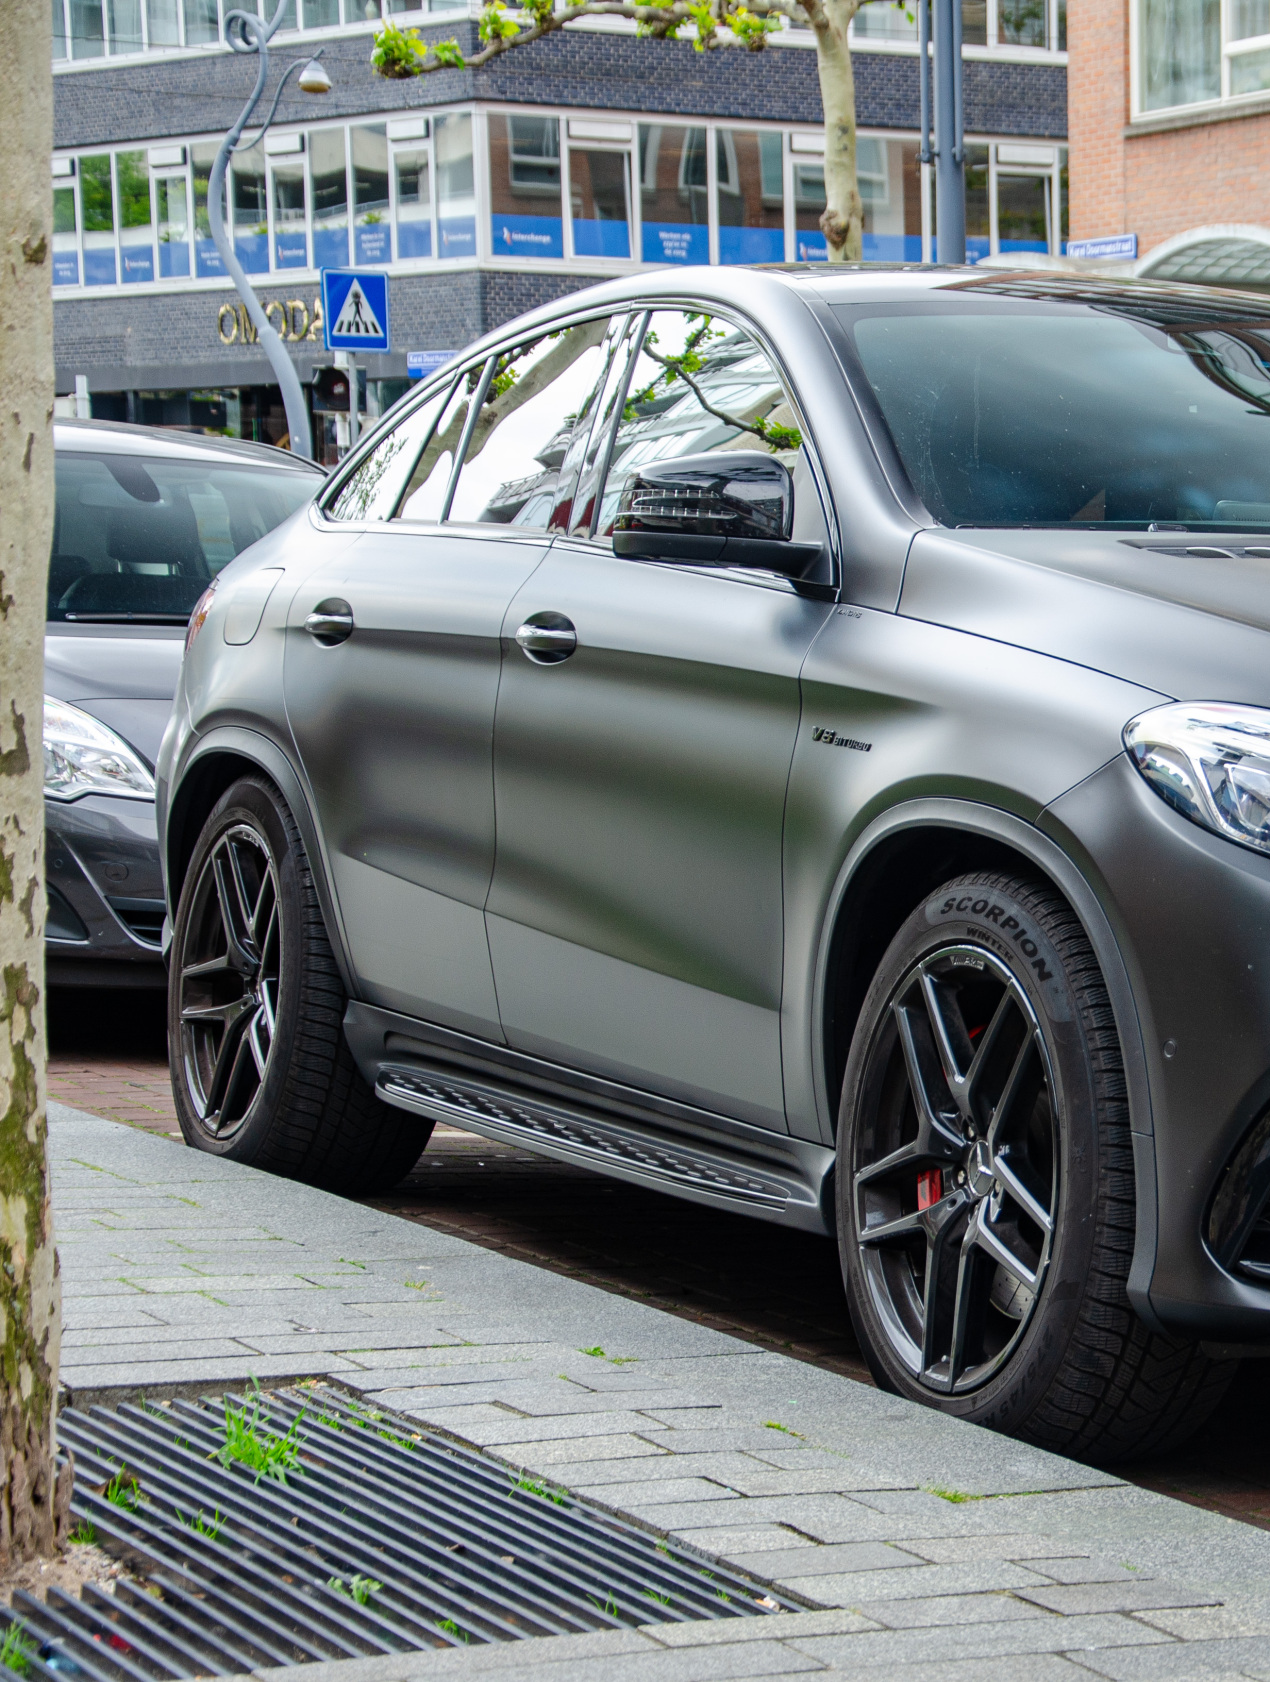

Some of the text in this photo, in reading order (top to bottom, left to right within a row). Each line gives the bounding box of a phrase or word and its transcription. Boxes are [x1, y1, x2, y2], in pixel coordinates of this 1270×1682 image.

[811, 725, 836, 744] V8
[940, 896, 1054, 983] SCORPION
[966, 926, 1014, 963] WINTER
